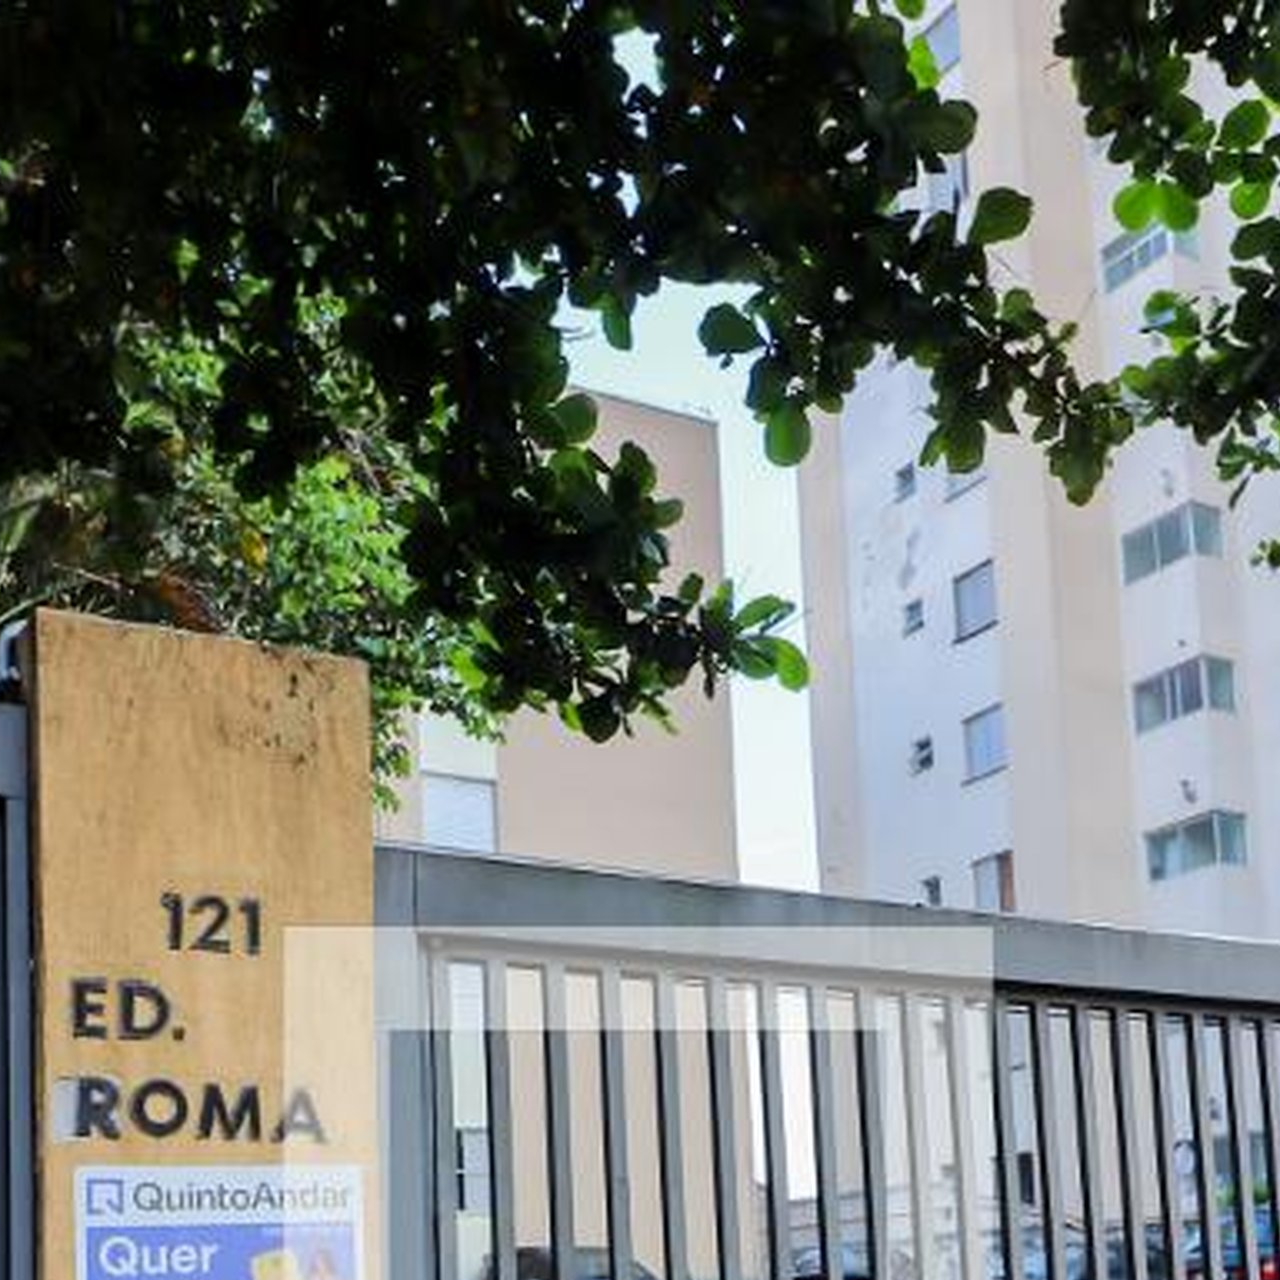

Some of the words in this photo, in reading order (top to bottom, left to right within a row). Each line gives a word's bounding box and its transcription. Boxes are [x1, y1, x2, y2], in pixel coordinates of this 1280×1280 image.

[160, 892, 262, 956] 121
[71, 977, 185, 1040] ED.
[73, 1076, 326, 1143] ROMA
[133, 1181, 349, 1214] QuintoAndar
[99, 1236, 218, 1276] Quer
